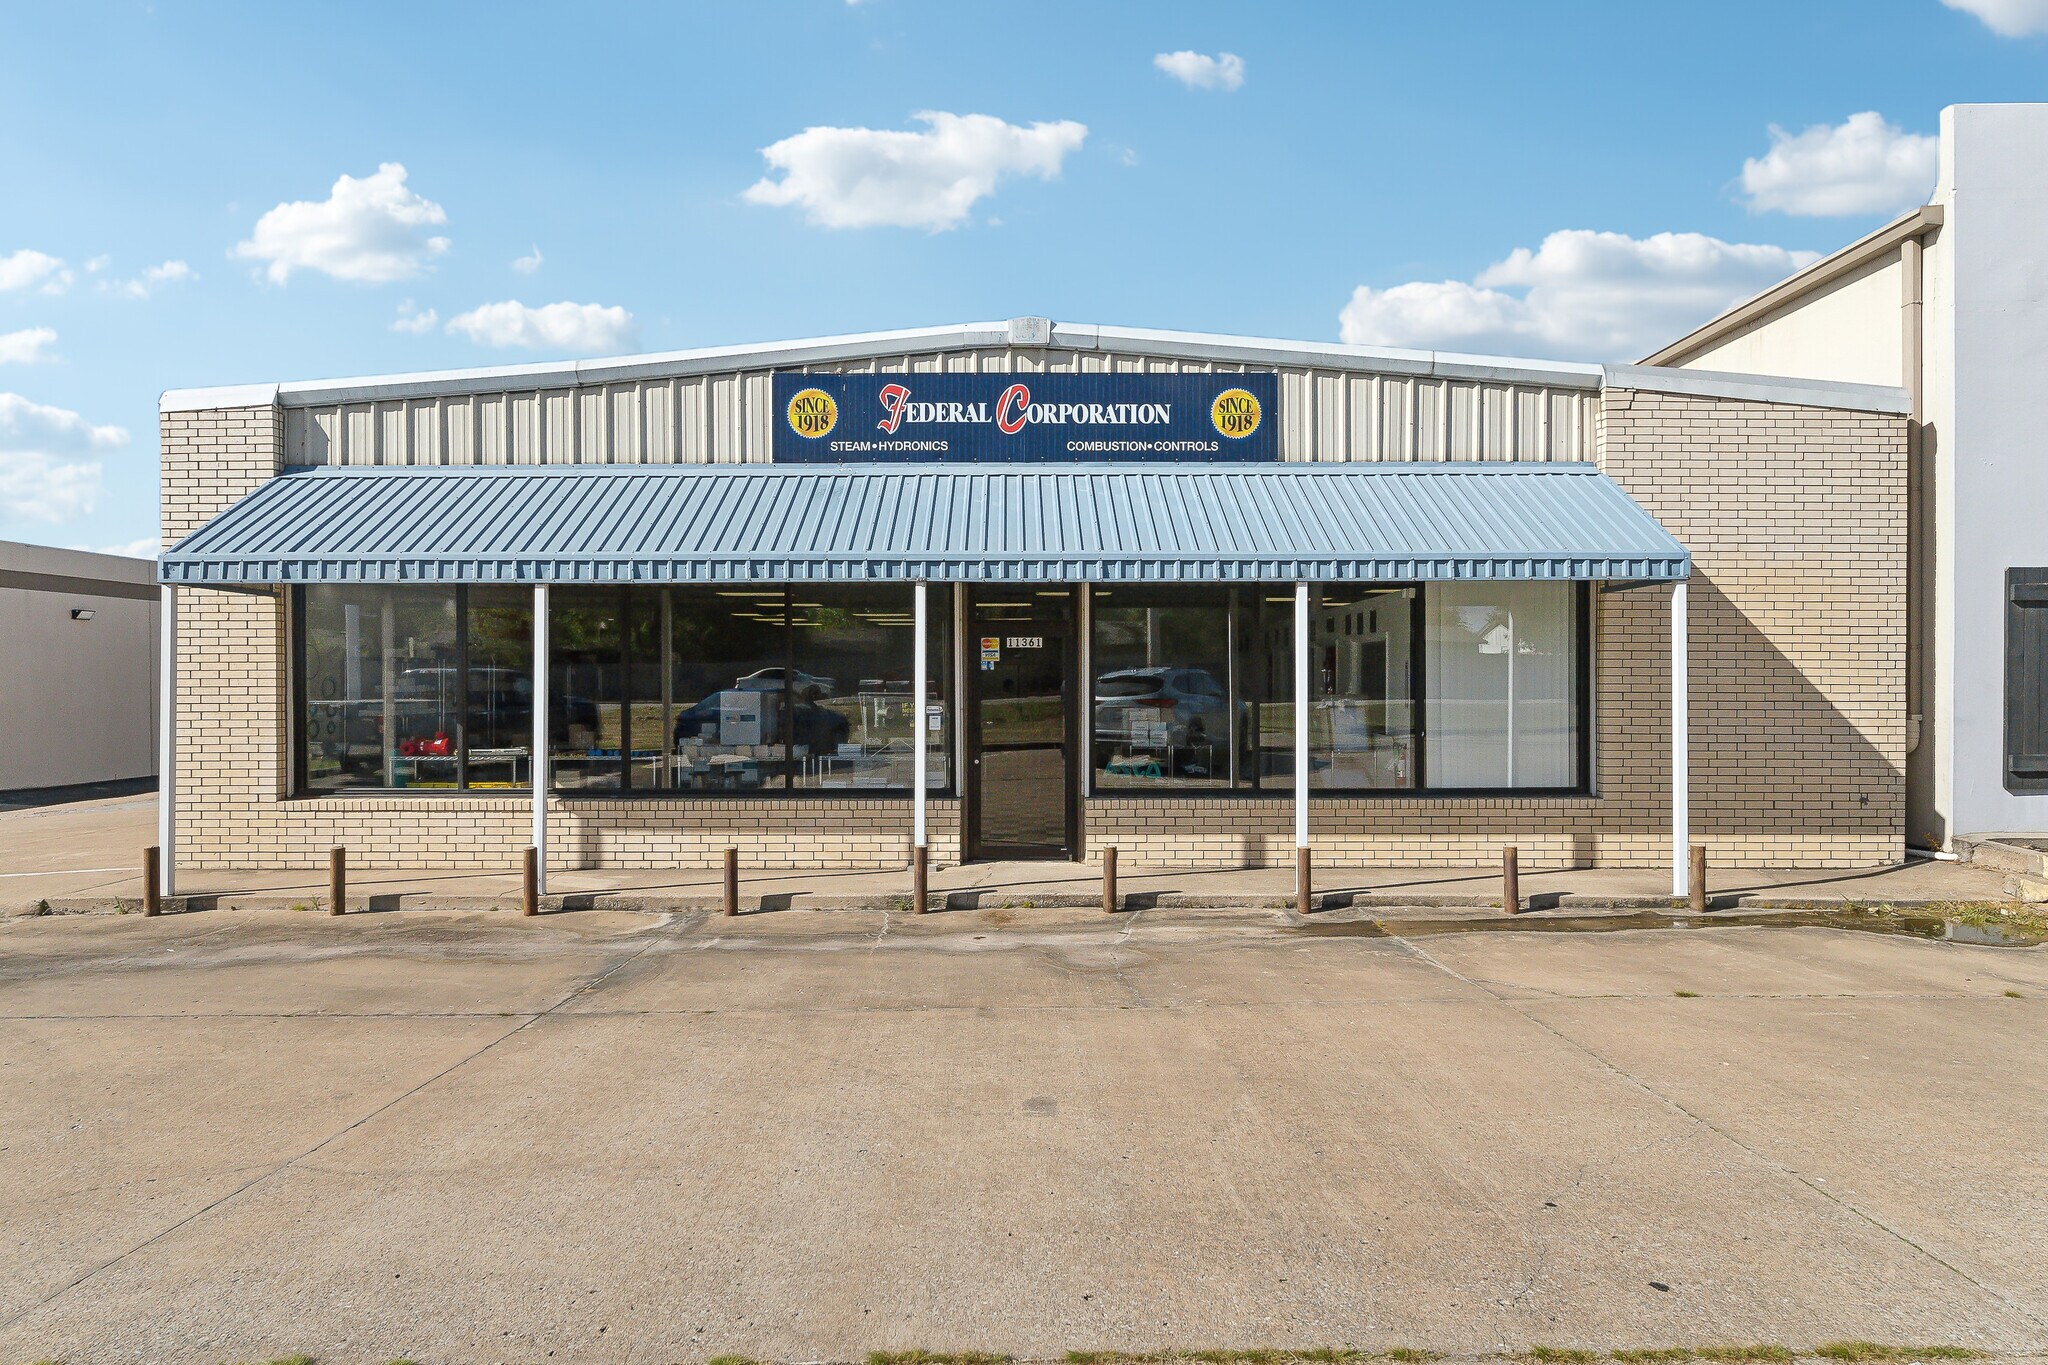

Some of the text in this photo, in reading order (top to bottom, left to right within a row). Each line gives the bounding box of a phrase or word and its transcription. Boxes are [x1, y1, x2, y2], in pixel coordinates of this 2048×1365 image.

[795, 397, 830, 413] SINCE
[877, 384, 1171, 434] FEDERAL CORPORATION
[1219, 397, 1253, 413] SINCE
[797, 415, 829, 432] 1918
[1221, 415, 1252, 432] 1918
[1008, 638, 1041, 647] 11361
